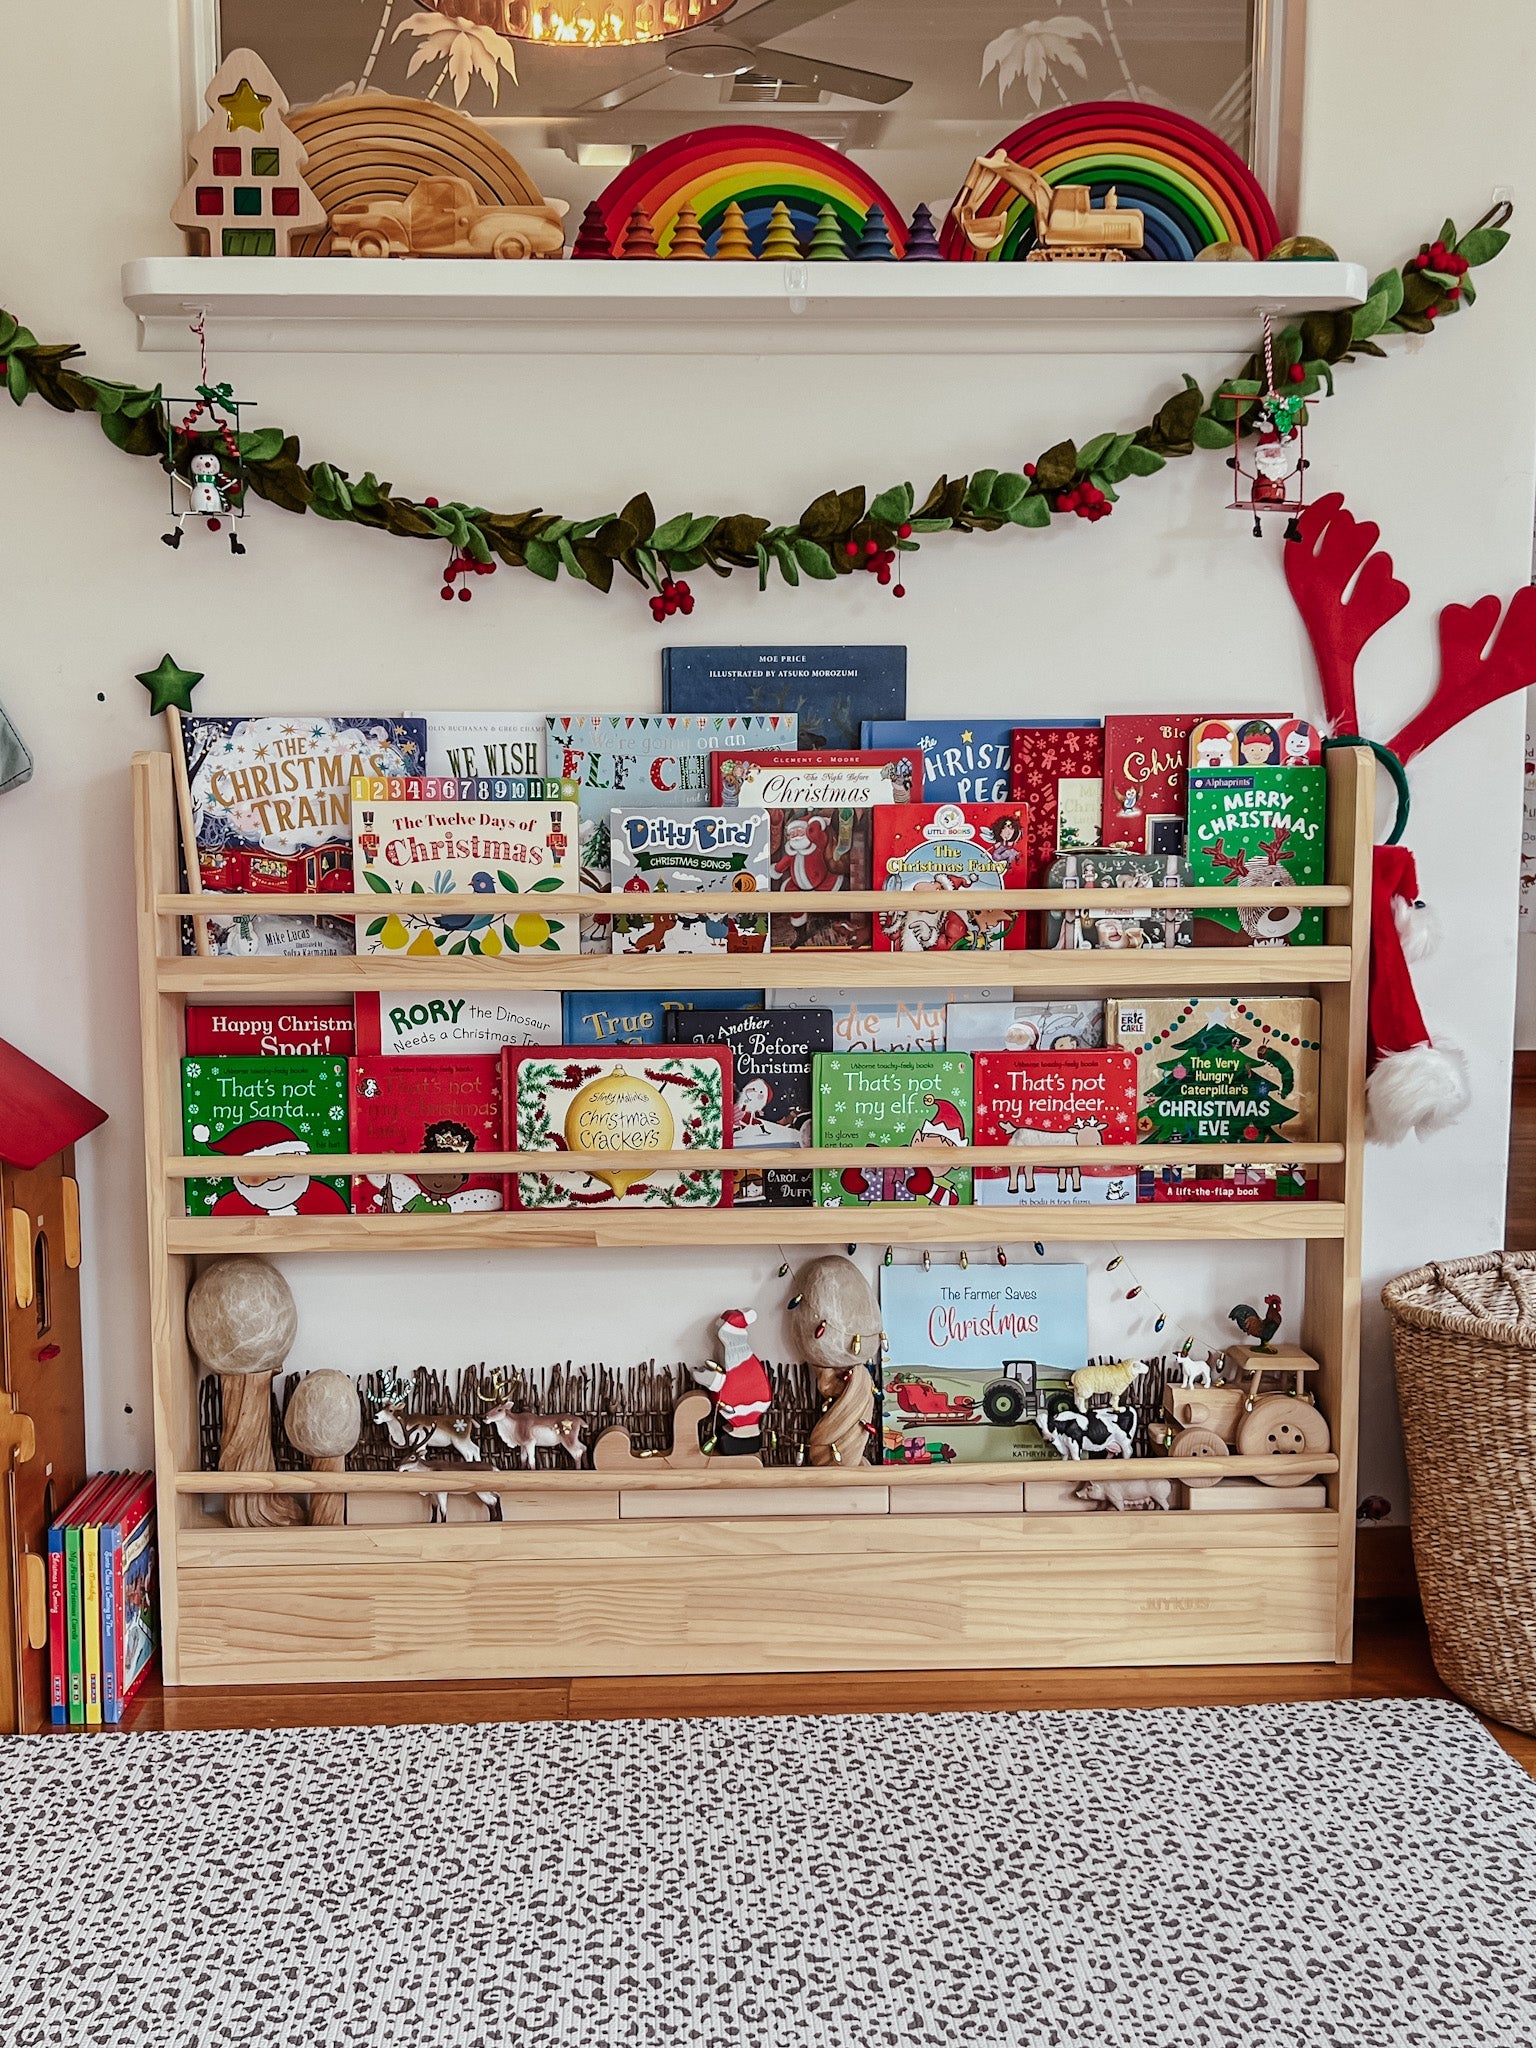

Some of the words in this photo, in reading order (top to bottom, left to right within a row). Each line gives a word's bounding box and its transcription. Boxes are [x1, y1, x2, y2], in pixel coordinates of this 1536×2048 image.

[759, 655, 778, 663] MOE
[781, 655, 807, 663] PRICE
[709, 670, 763, 678] ILLUSTRATED
[811, 669, 858, 677] MOROZUMI
[273, 737, 307, 758] THE
[697, 736, 720, 749] on
[725, 734, 746, 747] an
[917, 735, 938, 750] the
[446, 747, 479, 778] WE
[483, 742, 538, 776] WISH
[561, 747, 637, 790] ELF
[649, 754, 709, 792] CH
[922, 744, 1011, 785] HRIST
[1123, 747, 1183, 783] Chri
[211, 753, 384, 807] CHRISTMAS
[803, 773, 818, 781] The
[821, 773, 843, 783] Night
[846, 772, 869, 783] Before
[1205, 778, 1250, 788] Alphaprints
[355, 780, 363, 798] 1
[373, 781, 384, 799] 2
[391, 780, 401, 799] 3
[407, 781, 420, 799] 4
[426, 780, 436, 798] 5
[443, 780, 455, 799] 6
[460, 781, 472, 799] 7
[478, 781, 489, 800] 8
[495, 781, 507, 798] 9
[512, 782, 525, 798] 10
[530, 781, 541, 797] 11
[546, 782, 559, 798] 12
[762, 775, 870, 804] Christmas
[957, 777, 1009, 803] PEG
[1223, 790, 1294, 812] MERRY
[251, 793, 350, 836] TRAIN
[392, 816, 423, 831] The
[425, 812, 476, 827] Twelve
[479, 813, 515, 831] Days
[519, 818, 537, 832] of
[624, 818, 691, 850] Ditty
[692, 818, 753, 850] Bird
[1197, 810, 1319, 841] CHRISTMAS
[385, 831, 544, 867] Christmas
[934, 845, 961, 858] The
[650, 856, 699, 868] CHRISTMAS
[701, 860, 732, 870] SONGS
[887, 860, 963, 873] Christmas
[968, 861, 1007, 874] Fairy
[633, 882, 640, 890] 5
[265, 932, 285, 946] Mike
[286, 928, 310, 942] Lucas
[389, 998, 466, 1035] RORY
[469, 1004, 492, 1019] the
[496, 1005, 551, 1031] Dinosaur
[897, 990, 956, 1031] Nu
[1121, 1012, 1144, 1025] ERIC
[212, 1016, 273, 1035] Happy
[278, 1015, 355, 1031] Christm
[582, 1011, 654, 1040] True
[718, 1016, 770, 1039] Another
[1121, 1024, 1144, 1032] CARLE
[261, 1035, 330, 1055] Spot!
[393, 1032, 436, 1053] Needs
[440, 1031, 448, 1040] a
[452, 1028, 517, 1044] Christmas
[748, 1033, 808, 1055] Before
[737, 1053, 811, 1075] Christma
[877, 1062, 915, 1070] touchy-feely
[1190, 1057, 1211, 1069] The
[1215, 1057, 1239, 1071] Very
[217, 1077, 275, 1097] That's
[282, 1079, 316, 1097] not
[449, 1076, 482, 1095] not
[843, 1071, 901, 1092] That's
[908, 1073, 942, 1092] not
[1007, 1070, 1065, 1091] That's
[1072, 1073, 1106, 1092] not
[1195, 1071, 1234, 1084] Hungry
[1180, 1084, 1248, 1097] Caterpillar's
[213, 1105, 243, 1124] my
[249, 1100, 320, 1119] Santa...
[406, 1101, 498, 1117] Christmas
[855, 1100, 885, 1120] my
[891, 1093, 930, 1114] elf...
[992, 1098, 1022, 1118] my
[1029, 1092, 1120, 1113] reindeer...
[1158, 1100, 1270, 1117] CHRISTMAS
[580, 1109, 660, 1130] Christmas
[1198, 1120, 1230, 1136] EVE
[580, 1129, 660, 1151] Crackers
[835, 1130, 859, 1140] gloves
[767, 1170, 798, 1183] CAROL
[780, 1184, 812, 1197] DUFFY
[1167, 1187, 1174, 1195] A
[1176, 1186, 1235, 1197] lift-the-flap
[1237, 1187, 1259, 1196] book
[941, 1286, 961, 1300] The
[964, 1286, 1001, 1300] Farmer
[1005, 1286, 1037, 1300] Saves
[928, 1304, 1038, 1347] Christmas
[52, 1552, 61, 1582] Christmas
[50, 1590, 61, 1613] Coming
[103, 1591, 114, 1613] Coming
